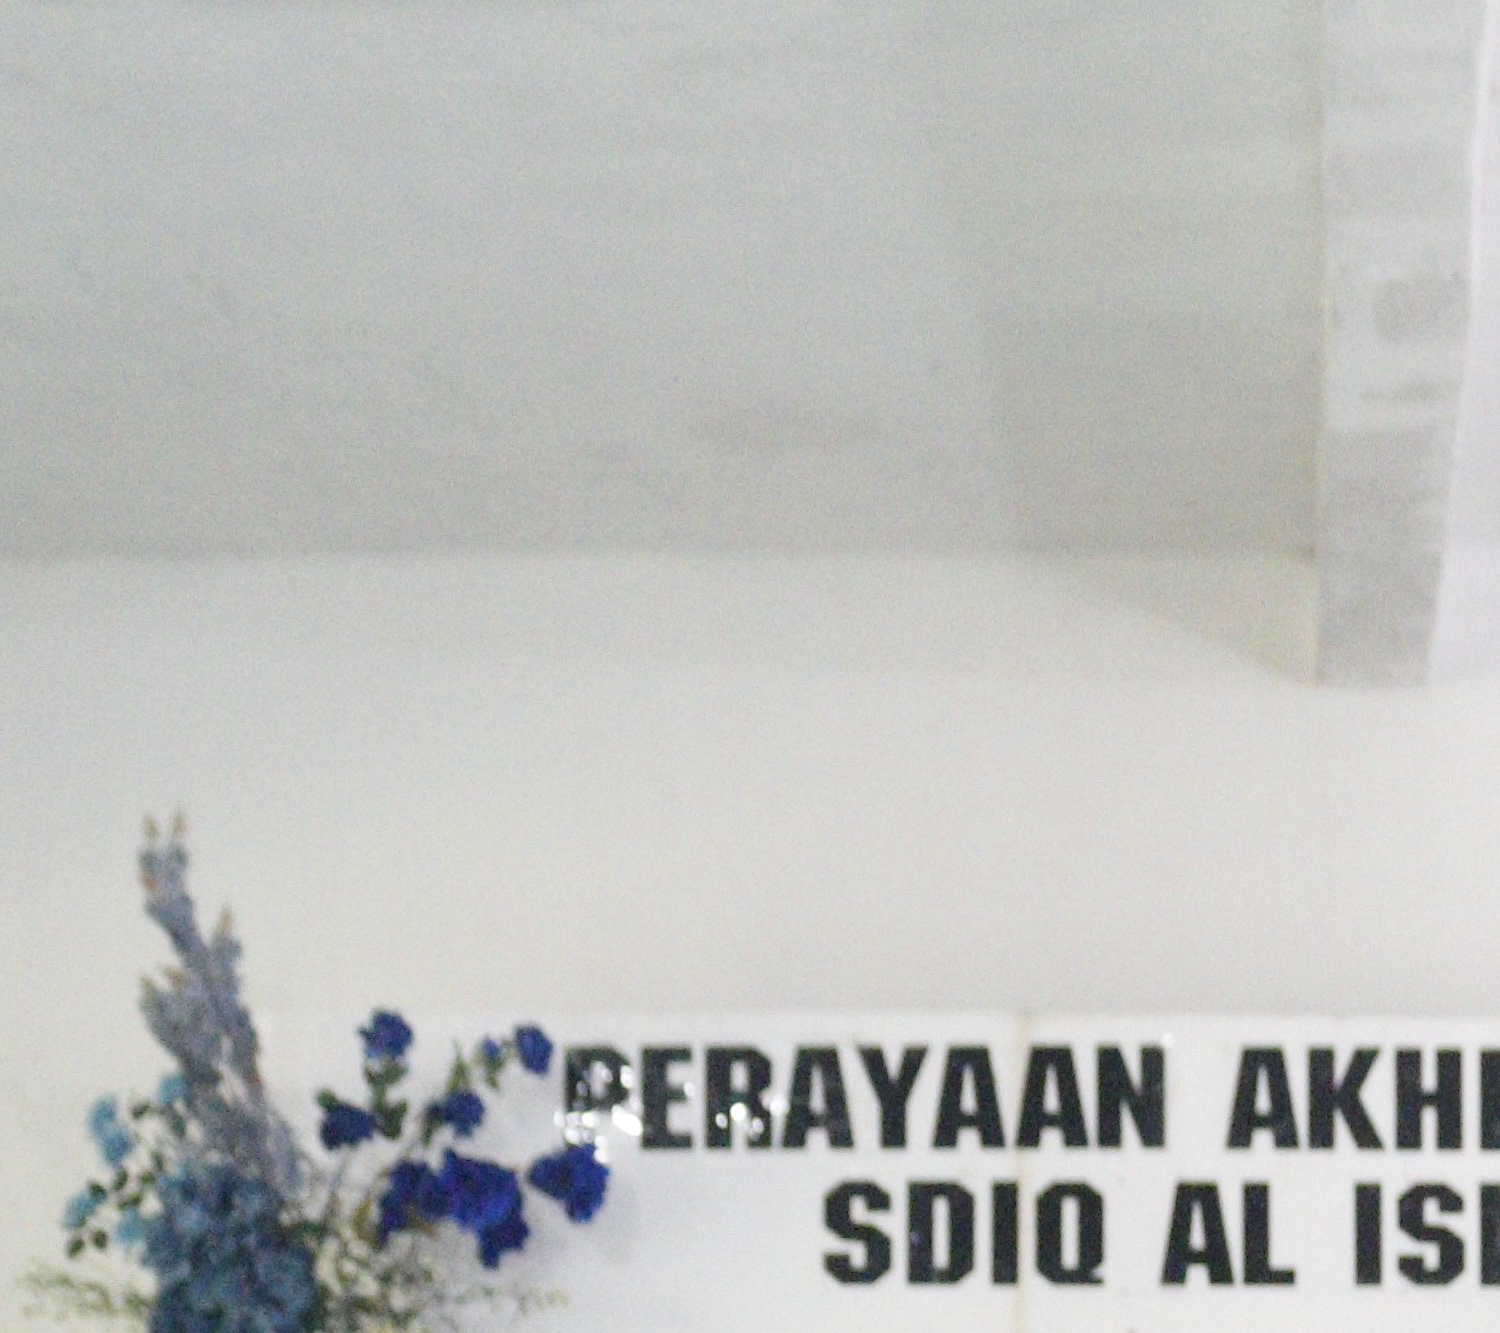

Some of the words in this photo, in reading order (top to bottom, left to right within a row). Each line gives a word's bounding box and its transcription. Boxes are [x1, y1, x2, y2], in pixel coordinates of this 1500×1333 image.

[562, 1046, 1165, 1150] PERAYAAN
[824, 1182, 1104, 1286] SDIQ
[1162, 1183, 1295, 1285] AL
